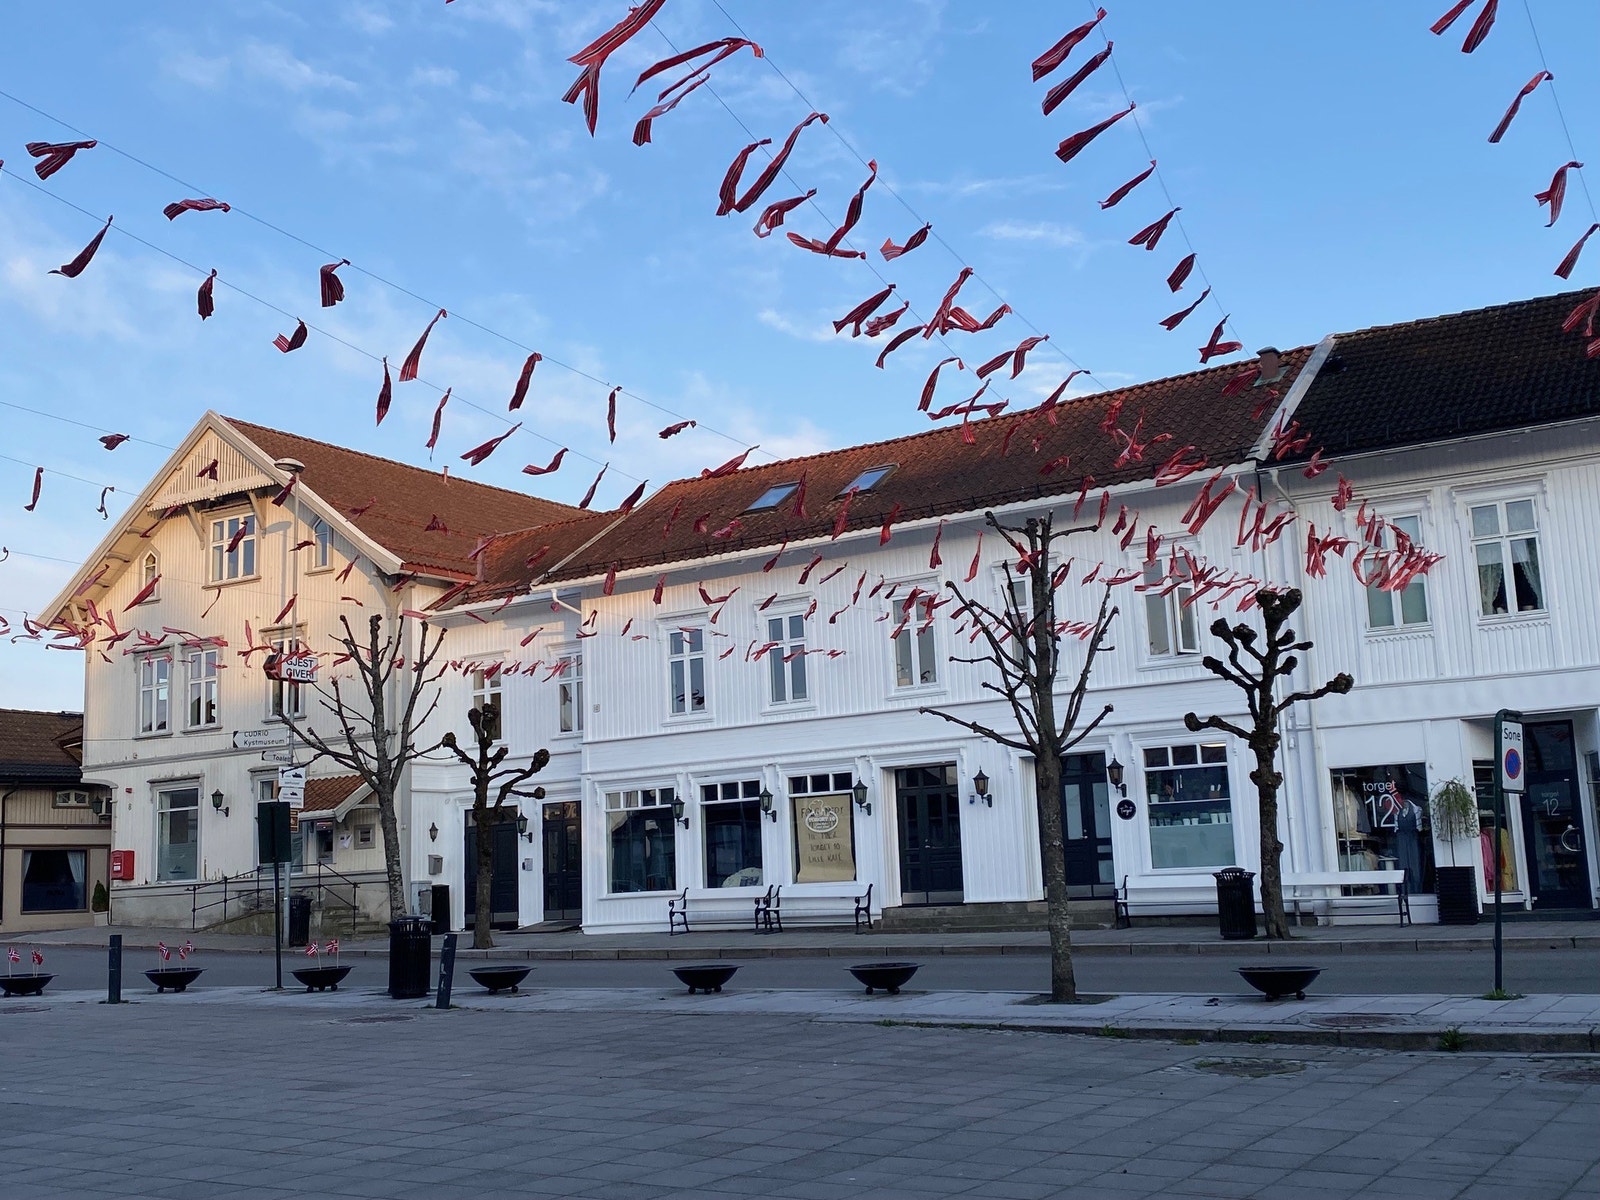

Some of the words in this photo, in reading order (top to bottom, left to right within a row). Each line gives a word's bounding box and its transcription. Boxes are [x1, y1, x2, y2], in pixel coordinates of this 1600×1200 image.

[286, 657, 314, 668] GJEST
[285, 667, 314, 679] GIVERI
[1503, 727, 1521, 741] Sone
[243, 739, 285, 747] Kystmuseum
[1362, 780, 1397, 793] torget
[1365, 793, 1399, 828] 12
[1542, 798, 1560, 816] 12
